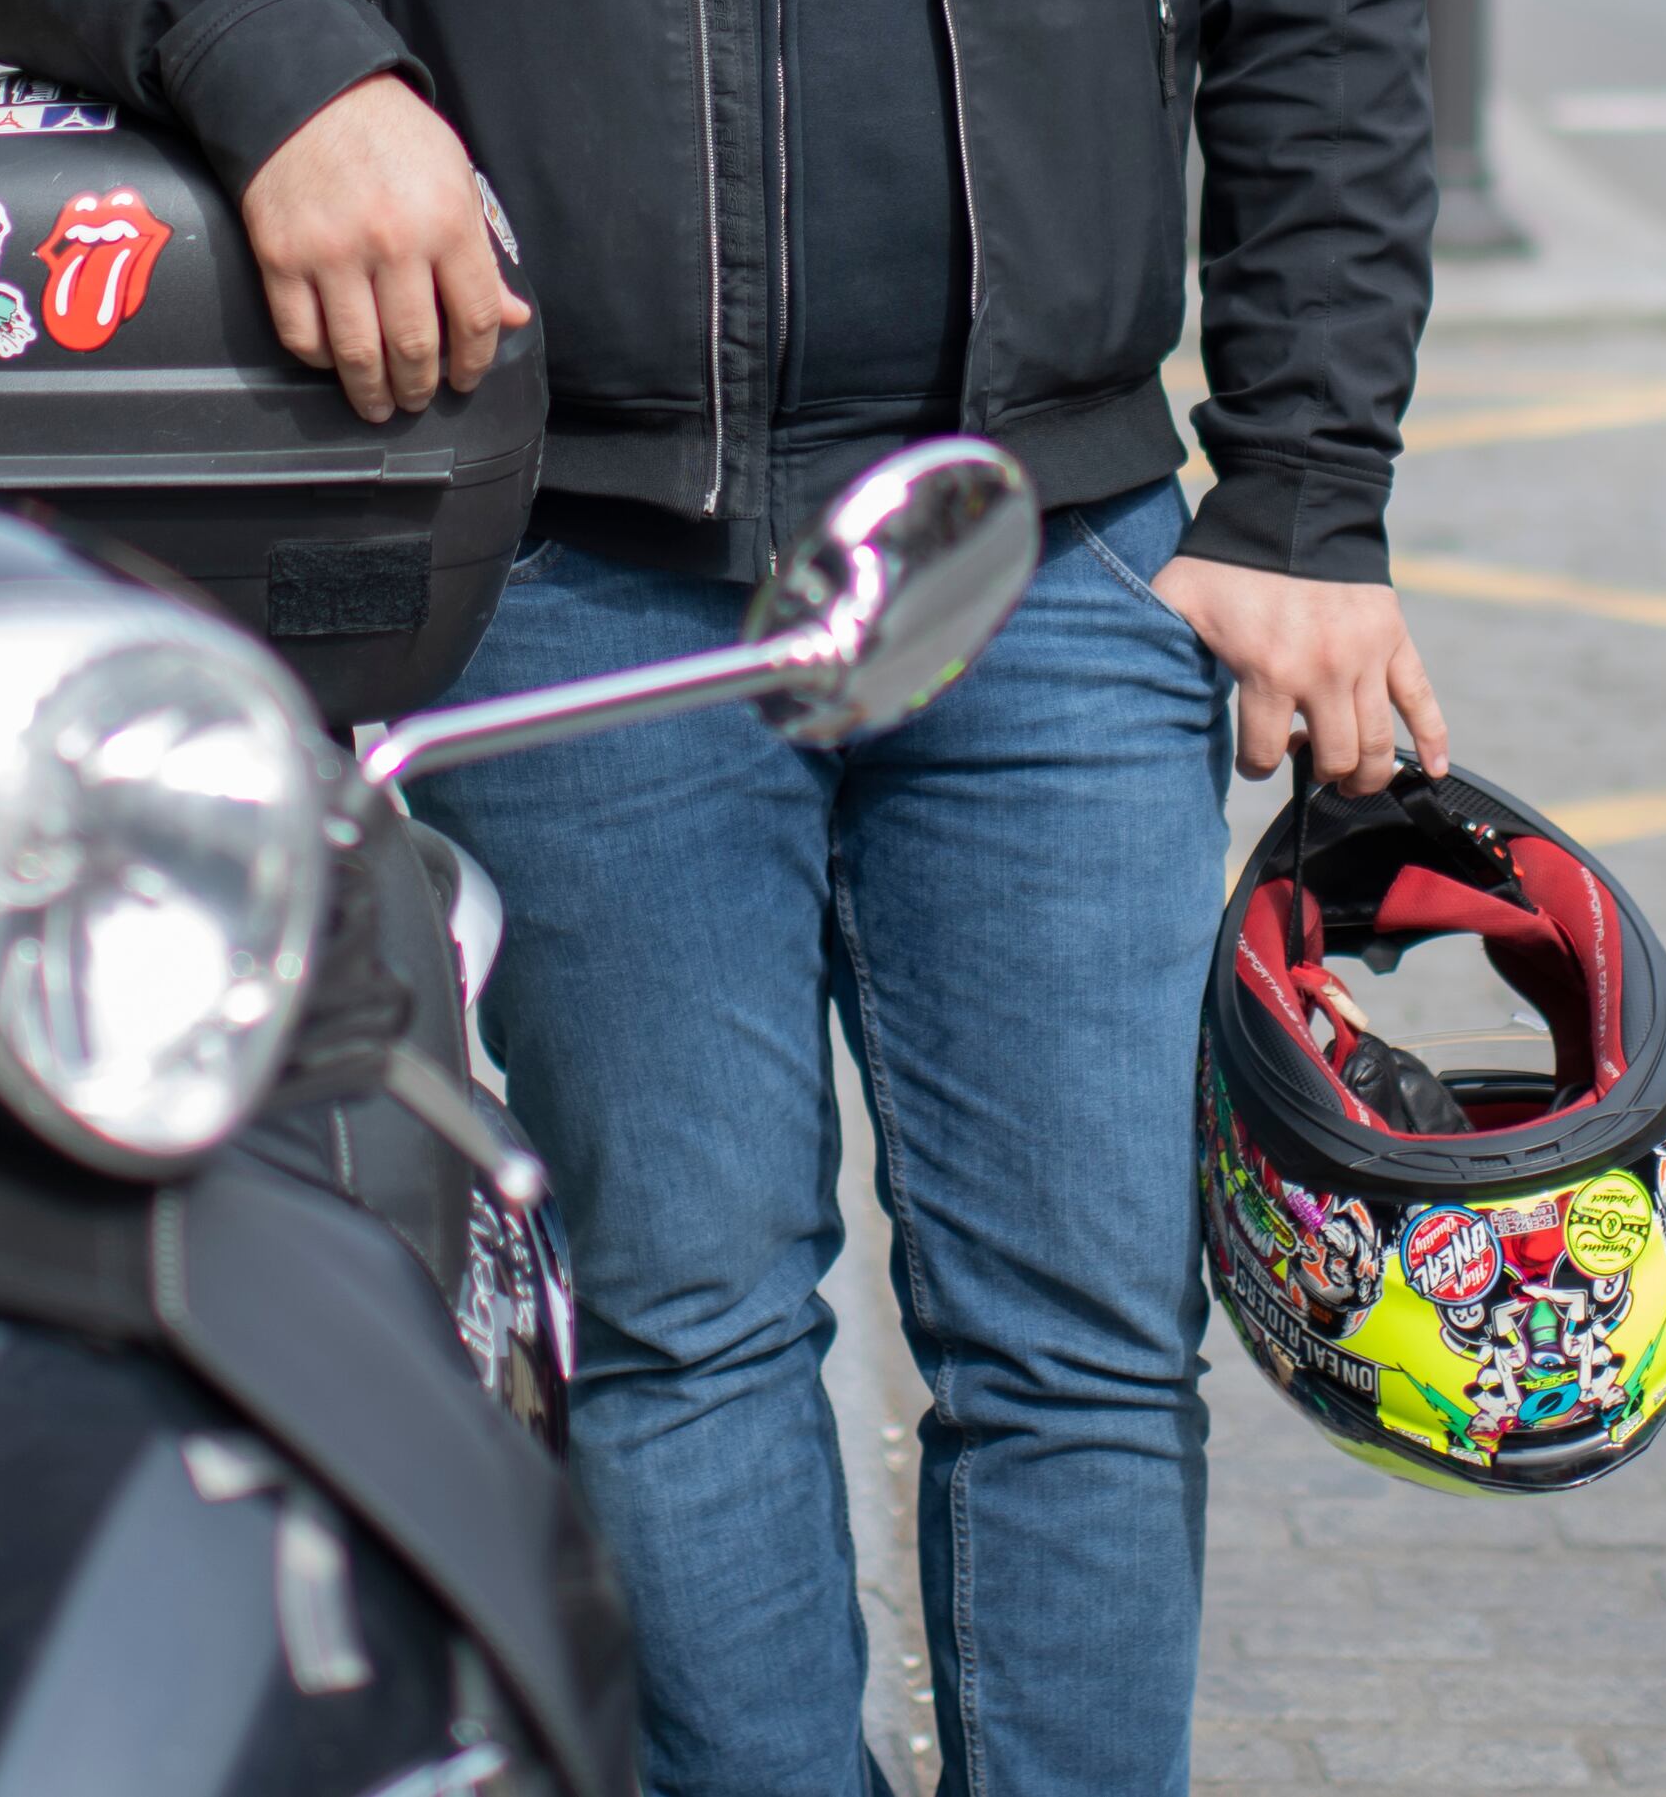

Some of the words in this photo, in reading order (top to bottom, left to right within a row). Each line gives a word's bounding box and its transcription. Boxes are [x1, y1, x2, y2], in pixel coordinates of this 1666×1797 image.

[1413, 1217, 1458, 1255] Quality
[1575, 1231, 1636, 1259] Genuine
[1451, 1263, 1489, 1297] High
